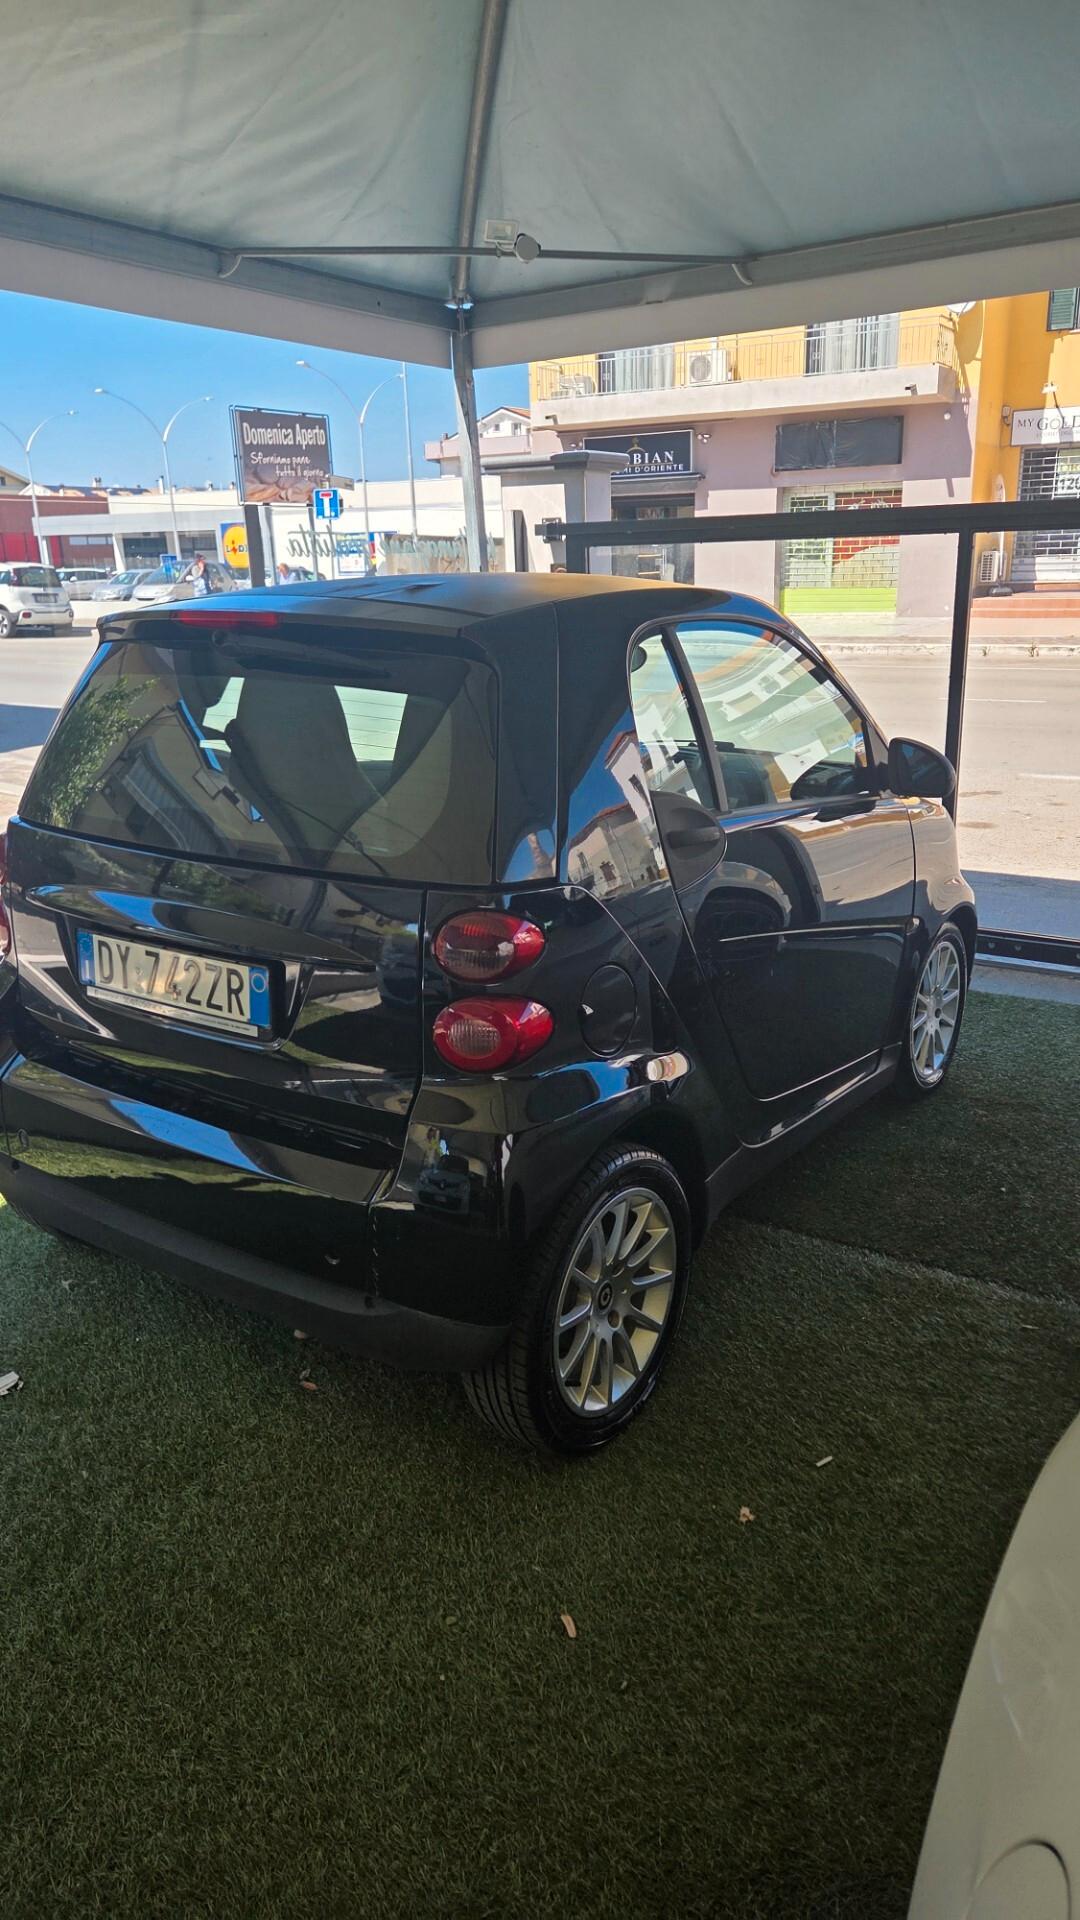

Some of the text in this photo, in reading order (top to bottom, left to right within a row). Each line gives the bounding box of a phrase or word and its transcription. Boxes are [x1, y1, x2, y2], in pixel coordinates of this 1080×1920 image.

[1017, 418, 1035, 428] MY
[242, 422, 326, 450] Domenica Aperto
[633, 450, 675, 465] BIAN
[634, 463, 684, 474] D'ORIENTE
[97, 939, 130, 990] DY
[144, 950, 246, 1017] 742ZR
